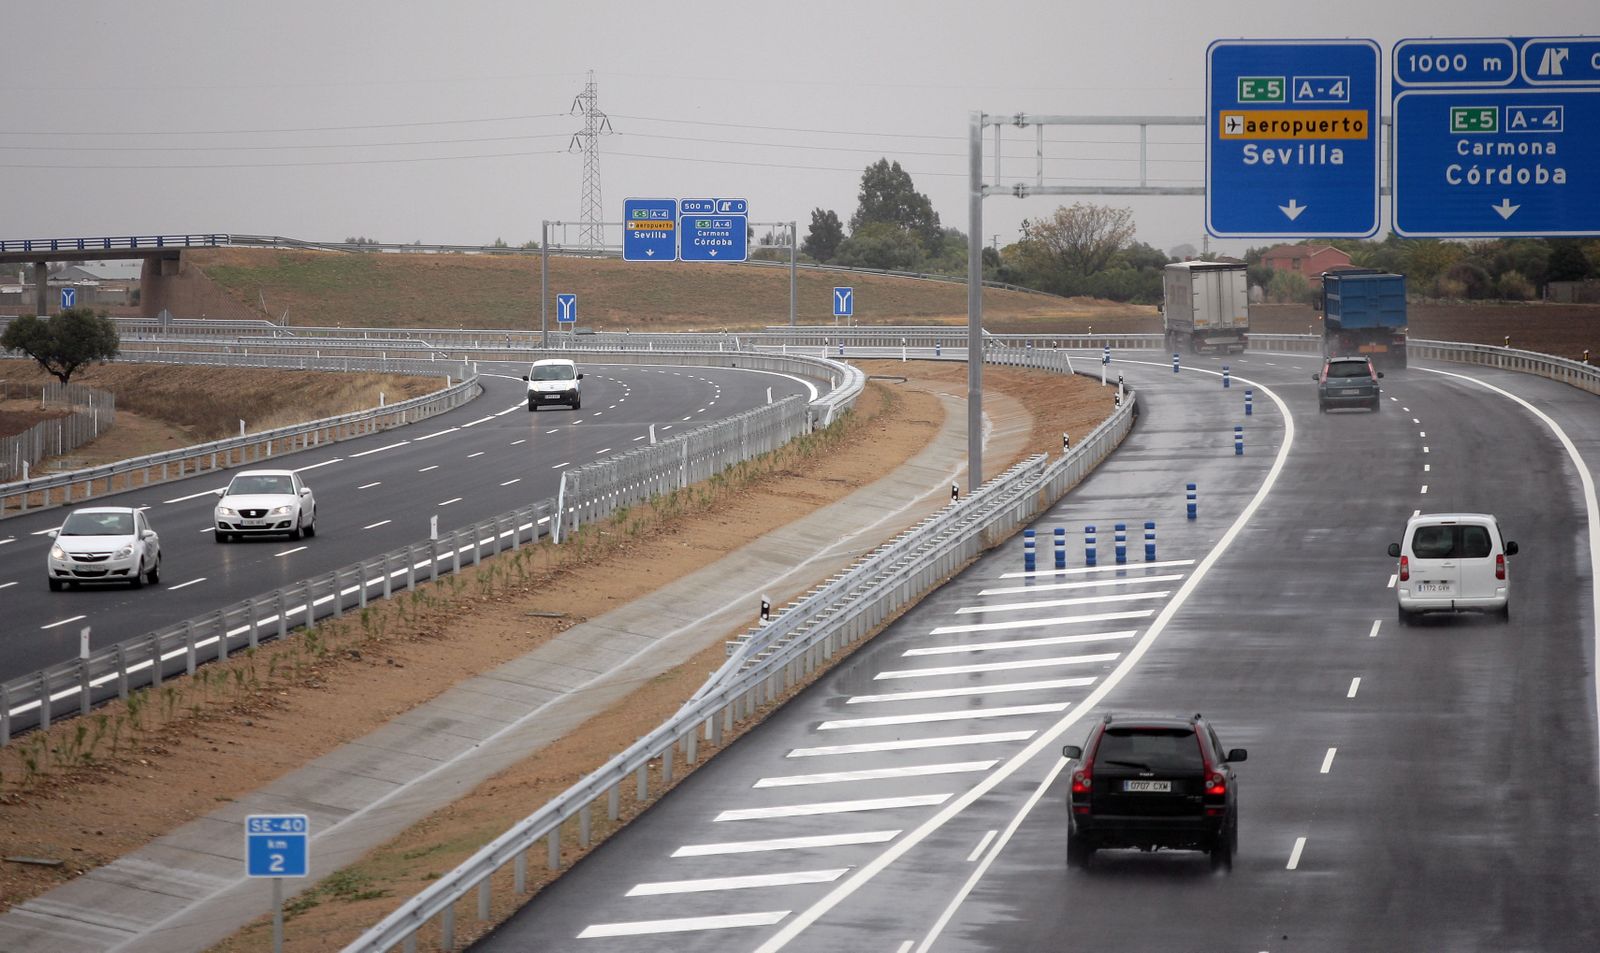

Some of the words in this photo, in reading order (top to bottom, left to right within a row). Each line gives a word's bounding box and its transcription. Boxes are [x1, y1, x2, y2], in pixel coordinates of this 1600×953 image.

[1409, 53, 1468, 73] 1000
[1483, 57, 1502, 72] m
[1242, 81, 1281, 98] E-5
[1298, 81, 1345, 98] A-4
[1246, 117, 1364, 137] aeropuerto
[1454, 111, 1494, 129] E-5
[1511, 110, 1558, 128] A-4
[1242, 143, 1344, 165] Sevilla
[1456, 140, 1557, 156] Carmona
[1445, 163, 1567, 185] Córdoba
[684, 202, 701, 210] 500
[634, 211, 648, 219] E-5
[652, 211, 667, 219] A-4
[714, 221, 730, 229] A-4
[634, 231, 667, 239] Sevilla
[251, 819, 304, 832] SE-40
[267, 839, 288, 850] km
[269, 854, 285, 872] 2
